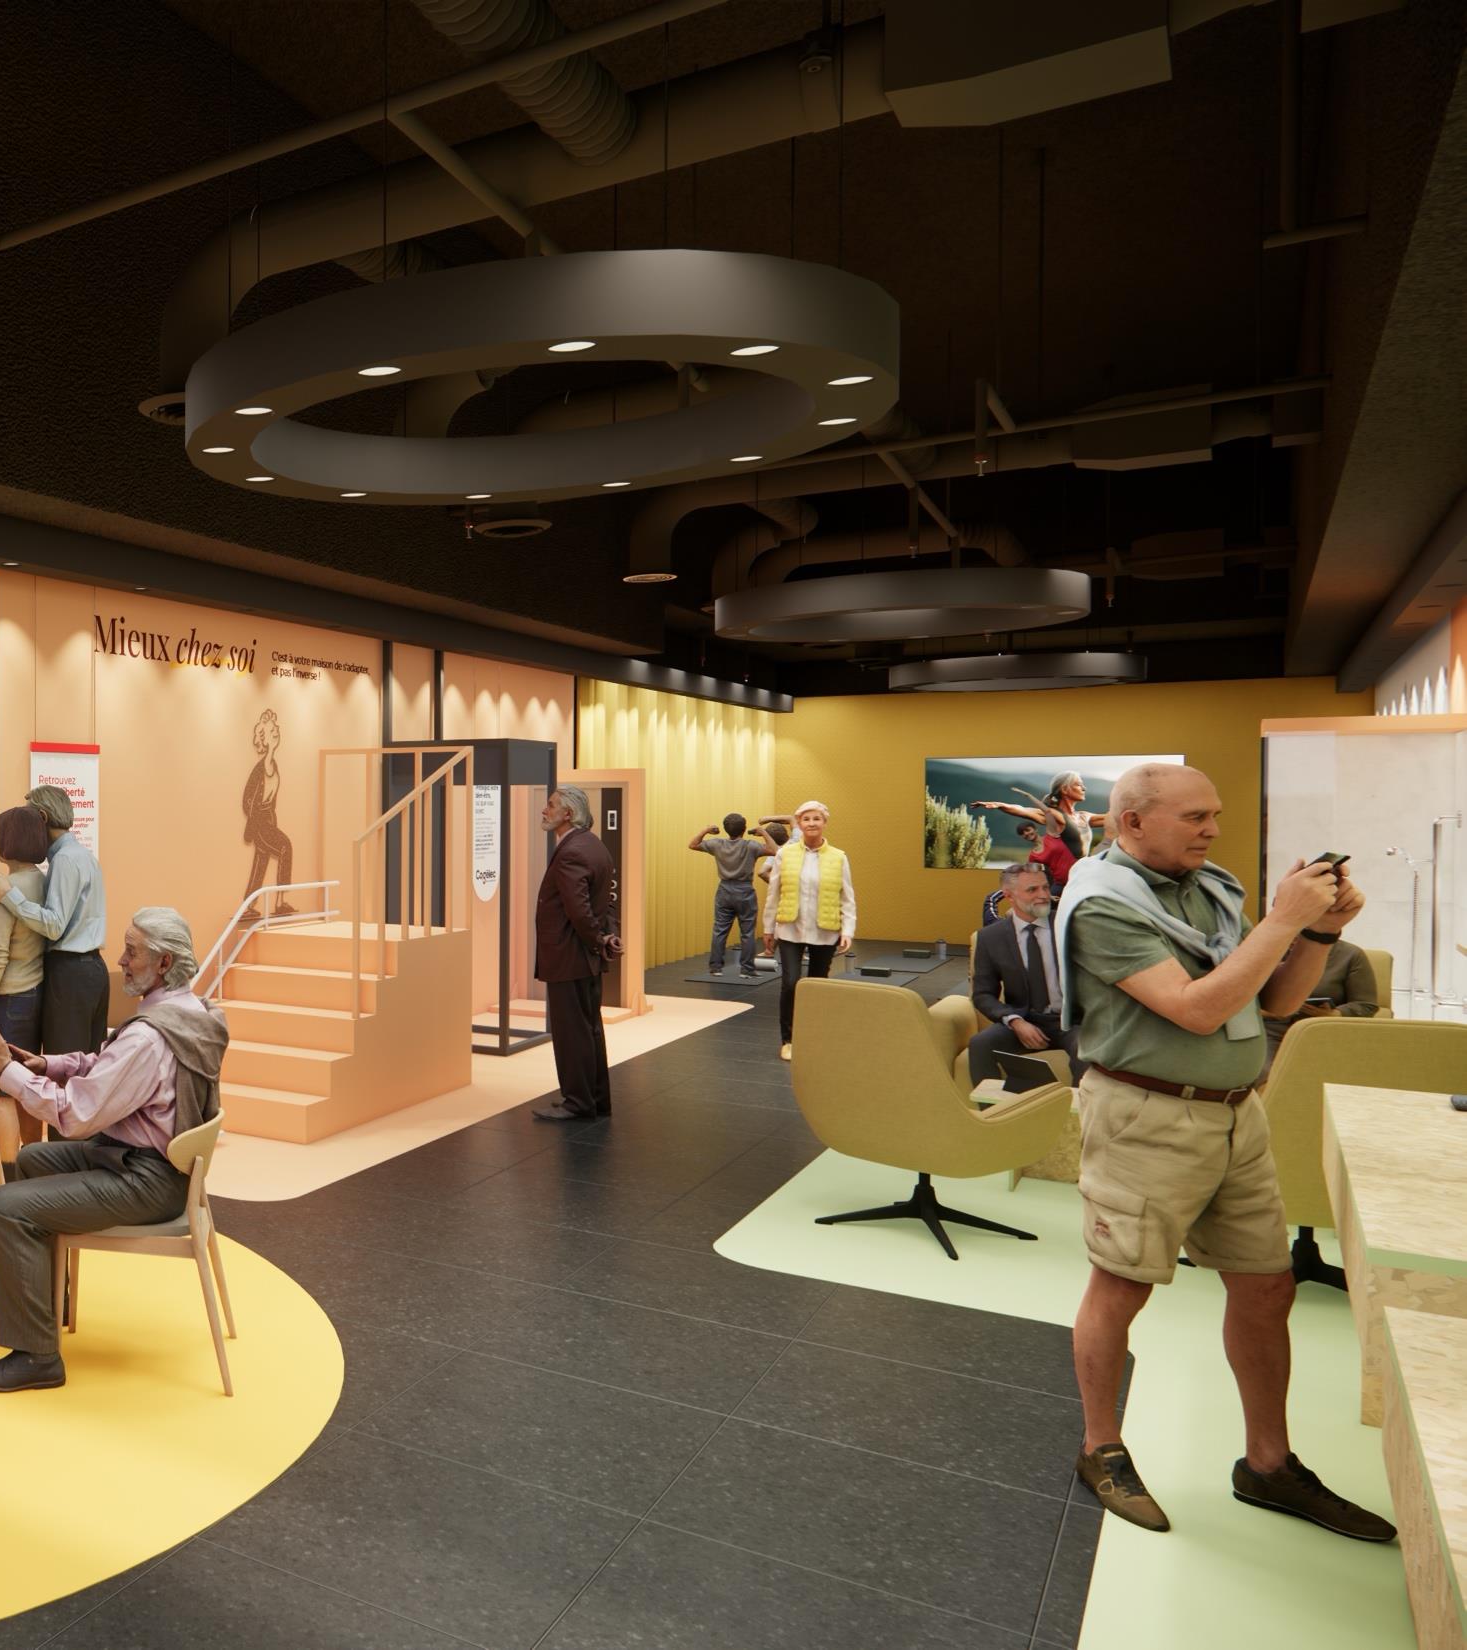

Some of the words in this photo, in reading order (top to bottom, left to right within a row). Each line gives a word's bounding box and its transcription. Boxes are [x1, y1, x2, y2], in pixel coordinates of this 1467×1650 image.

[94, 615, 170, 662] Mieux
[176, 628, 224, 668] chez
[227, 639, 257, 673] soi
[271, 651, 288, 663] C'est
[294, 656, 310, 666] votre
[311, 658, 333, 669] maison
[335, 661, 343, 671] de
[271, 666, 278, 675] et
[280, 668, 291, 678] pas
[293, 668, 317, 680] l'inverse
[38, 775, 76, 785] Retrouvez
[64, 787, 85, 797] berté
[71, 800, 94, 808] ement
